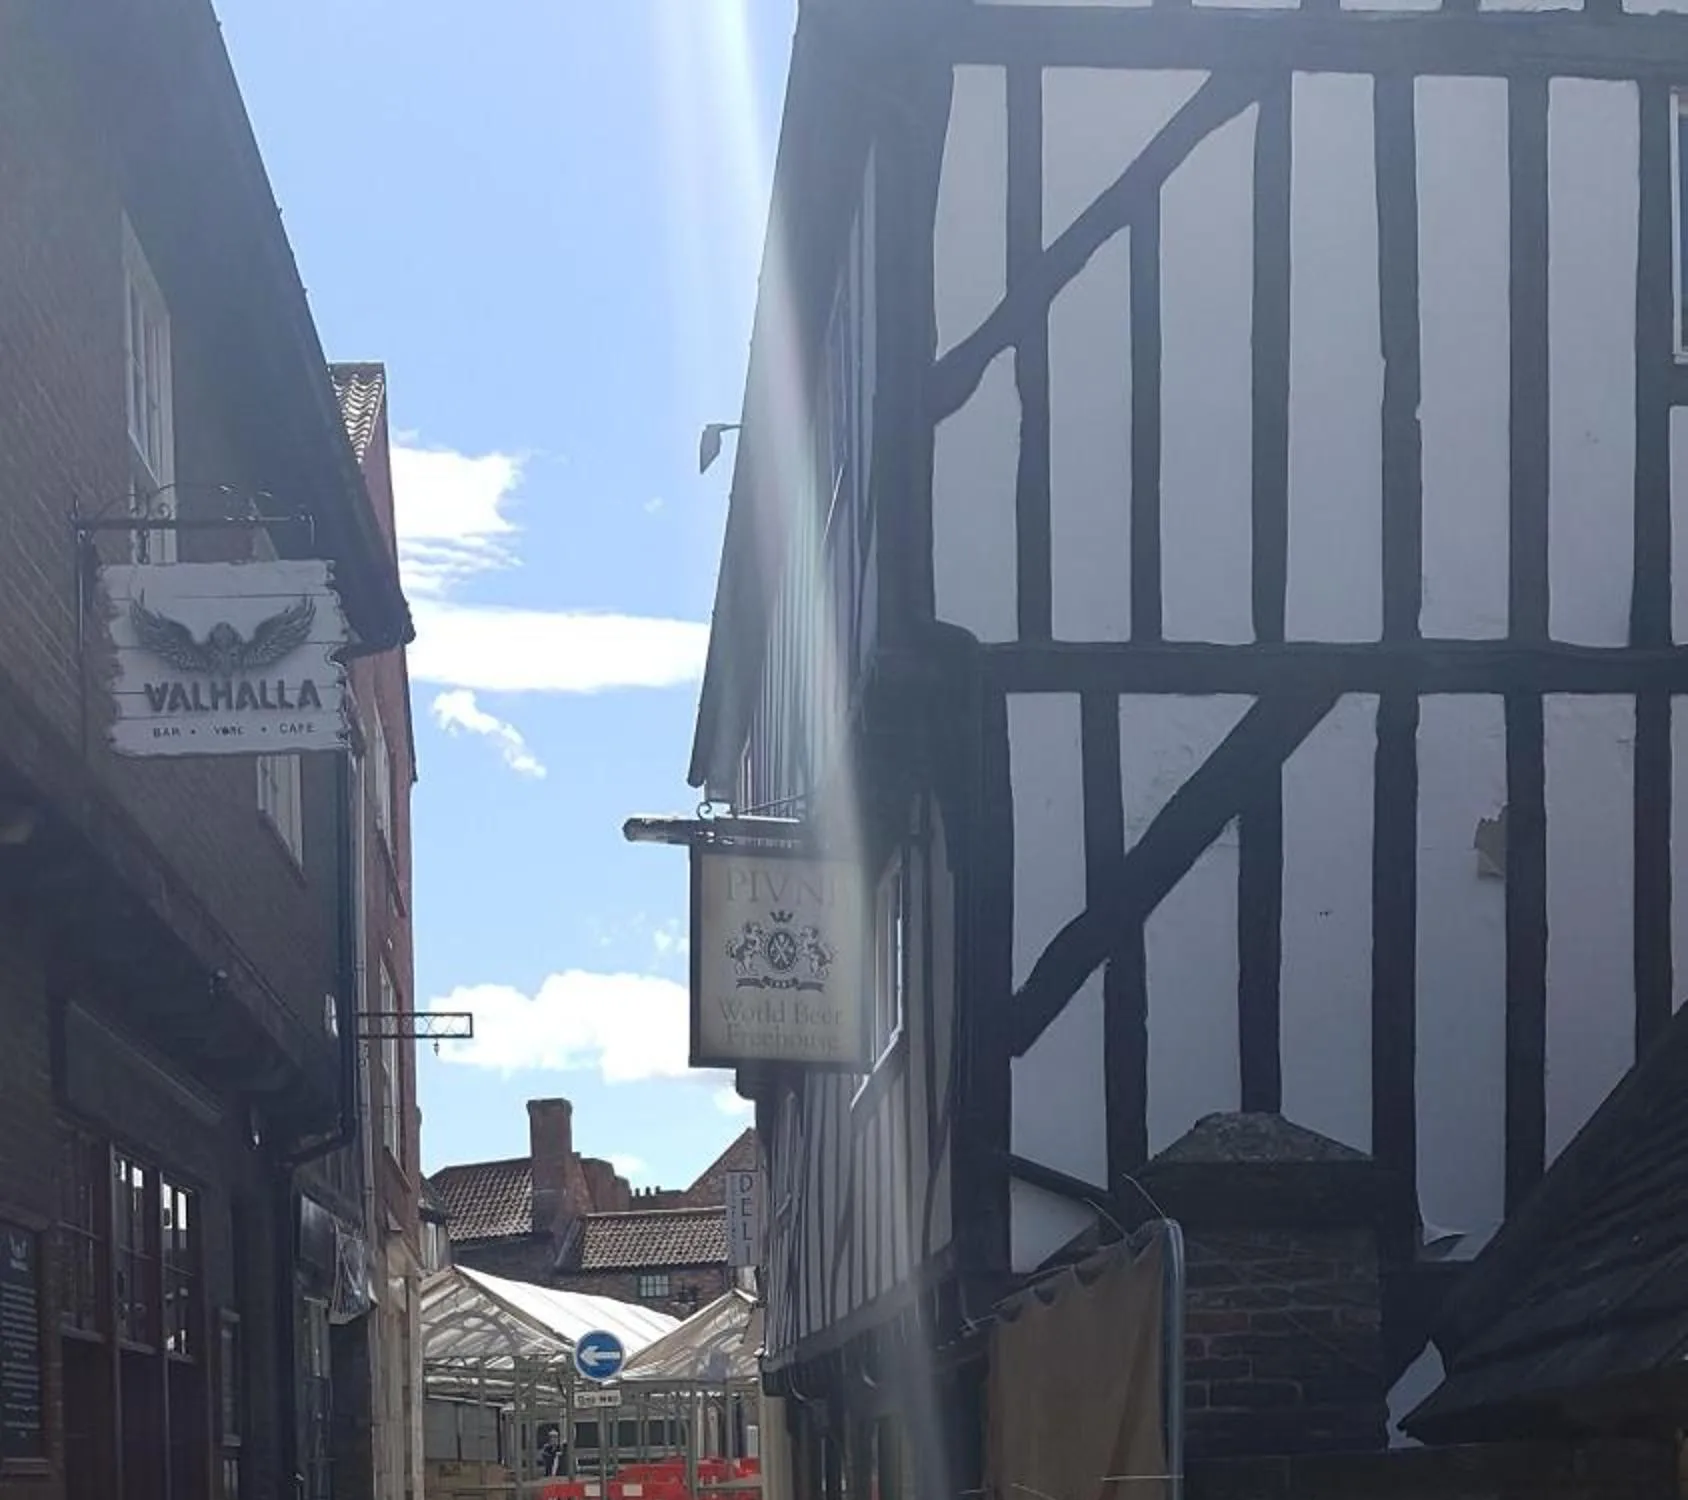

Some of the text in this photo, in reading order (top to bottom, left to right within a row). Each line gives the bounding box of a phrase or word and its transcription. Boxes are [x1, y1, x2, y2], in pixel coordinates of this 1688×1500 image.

[143, 678, 322, 712] VALHALLA
[153, 726, 181, 738] BAR
[718, 997, 844, 1025] World Beer
[739, 1173, 753, 1265] DELI
